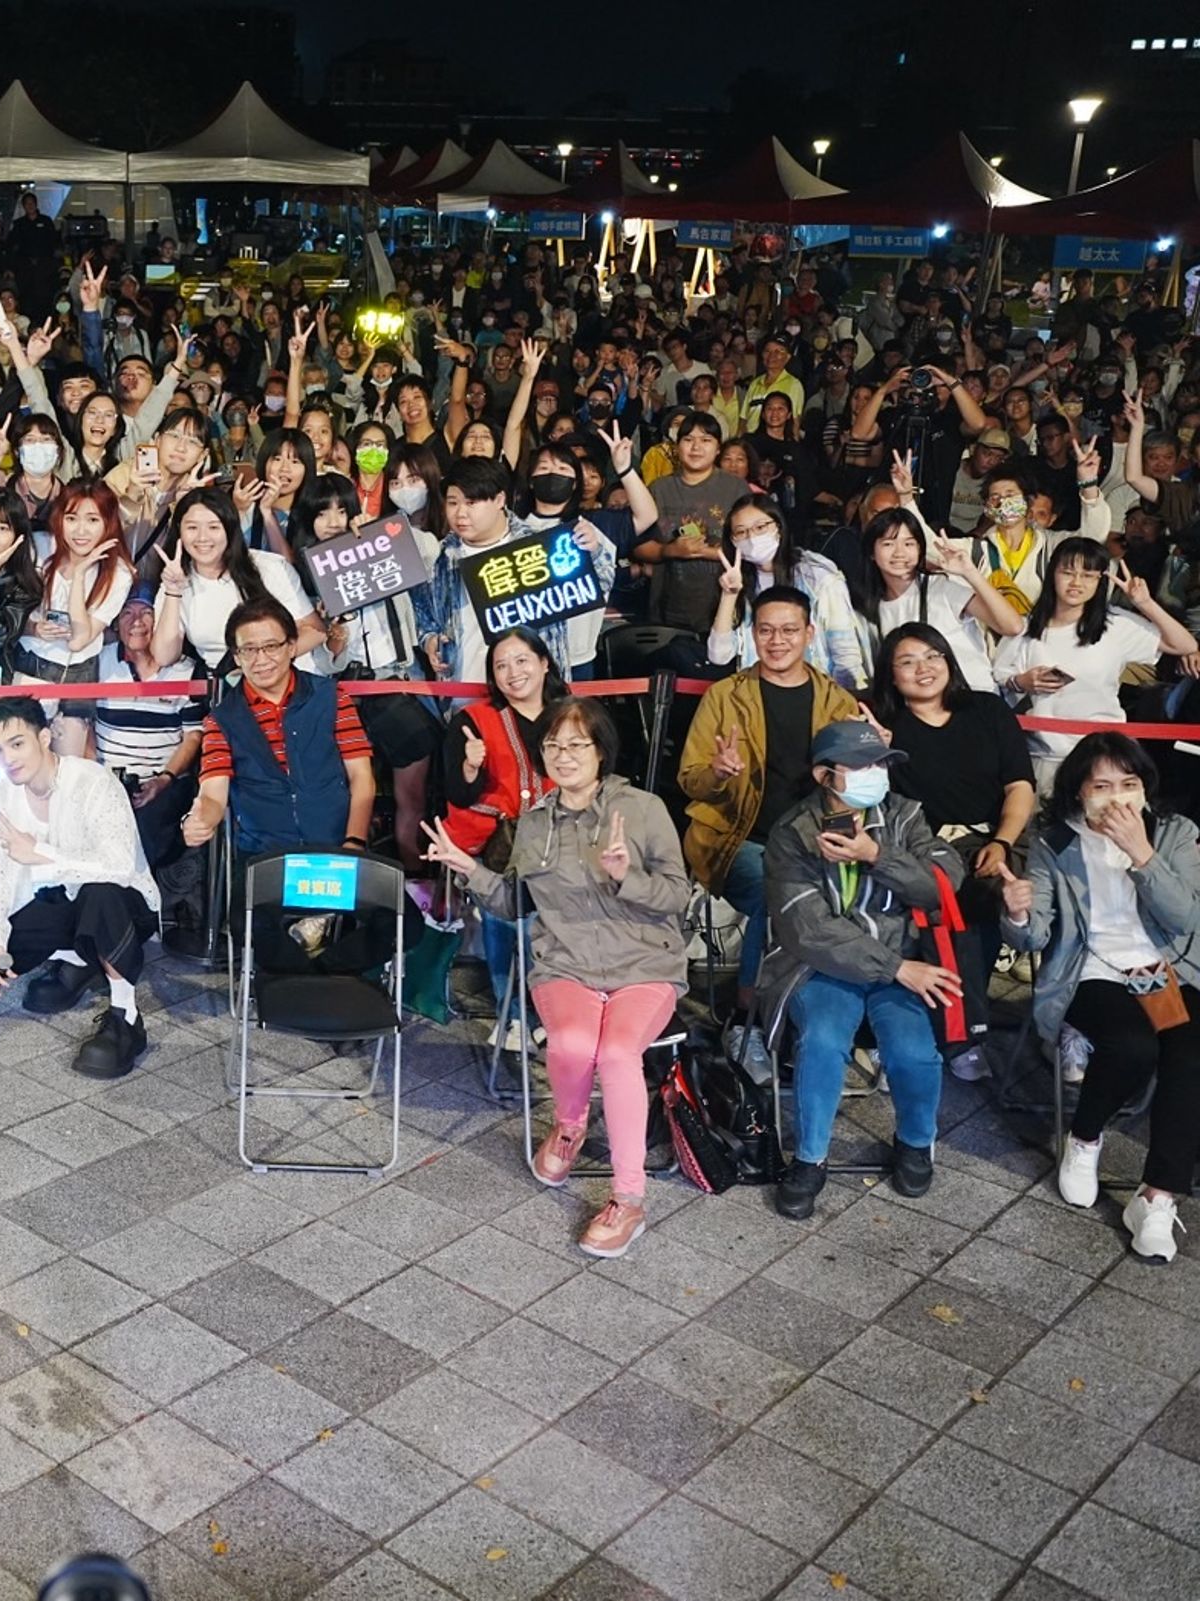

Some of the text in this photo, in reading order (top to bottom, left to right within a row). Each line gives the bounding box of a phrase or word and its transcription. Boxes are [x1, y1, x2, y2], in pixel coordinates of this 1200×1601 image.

[311, 535, 392, 577] Hane
[334, 553, 403, 607] 偉晉
[477, 543, 551, 598] 偉晉
